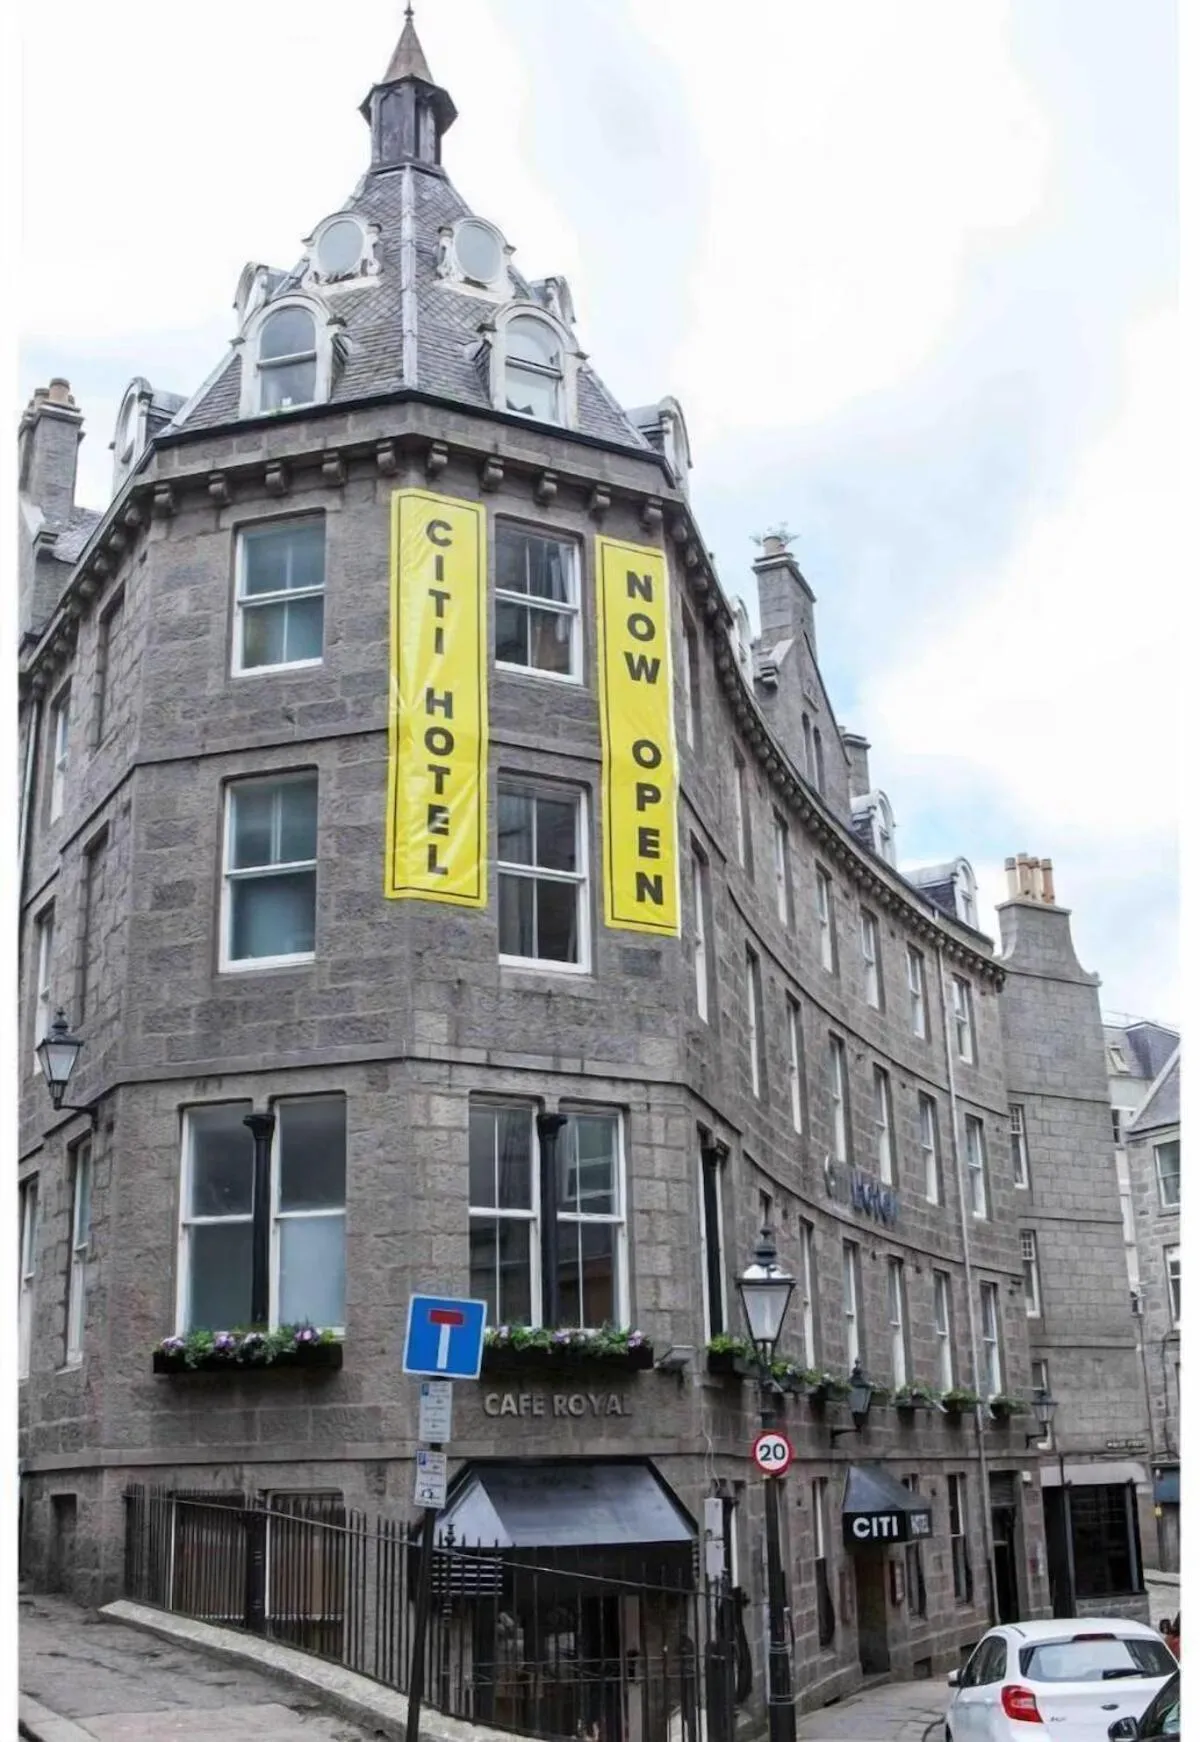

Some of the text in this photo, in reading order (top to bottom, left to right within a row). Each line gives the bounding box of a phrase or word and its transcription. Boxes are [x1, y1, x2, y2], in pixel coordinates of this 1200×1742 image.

[424, 519, 455, 876] CITI HOTEL
[623, 569, 664, 906] NOW OPEN
[484, 1393, 545, 1416] CAFE
[760, 1443, 785, 1461] 20
[852, 1516, 898, 1538] CITI
